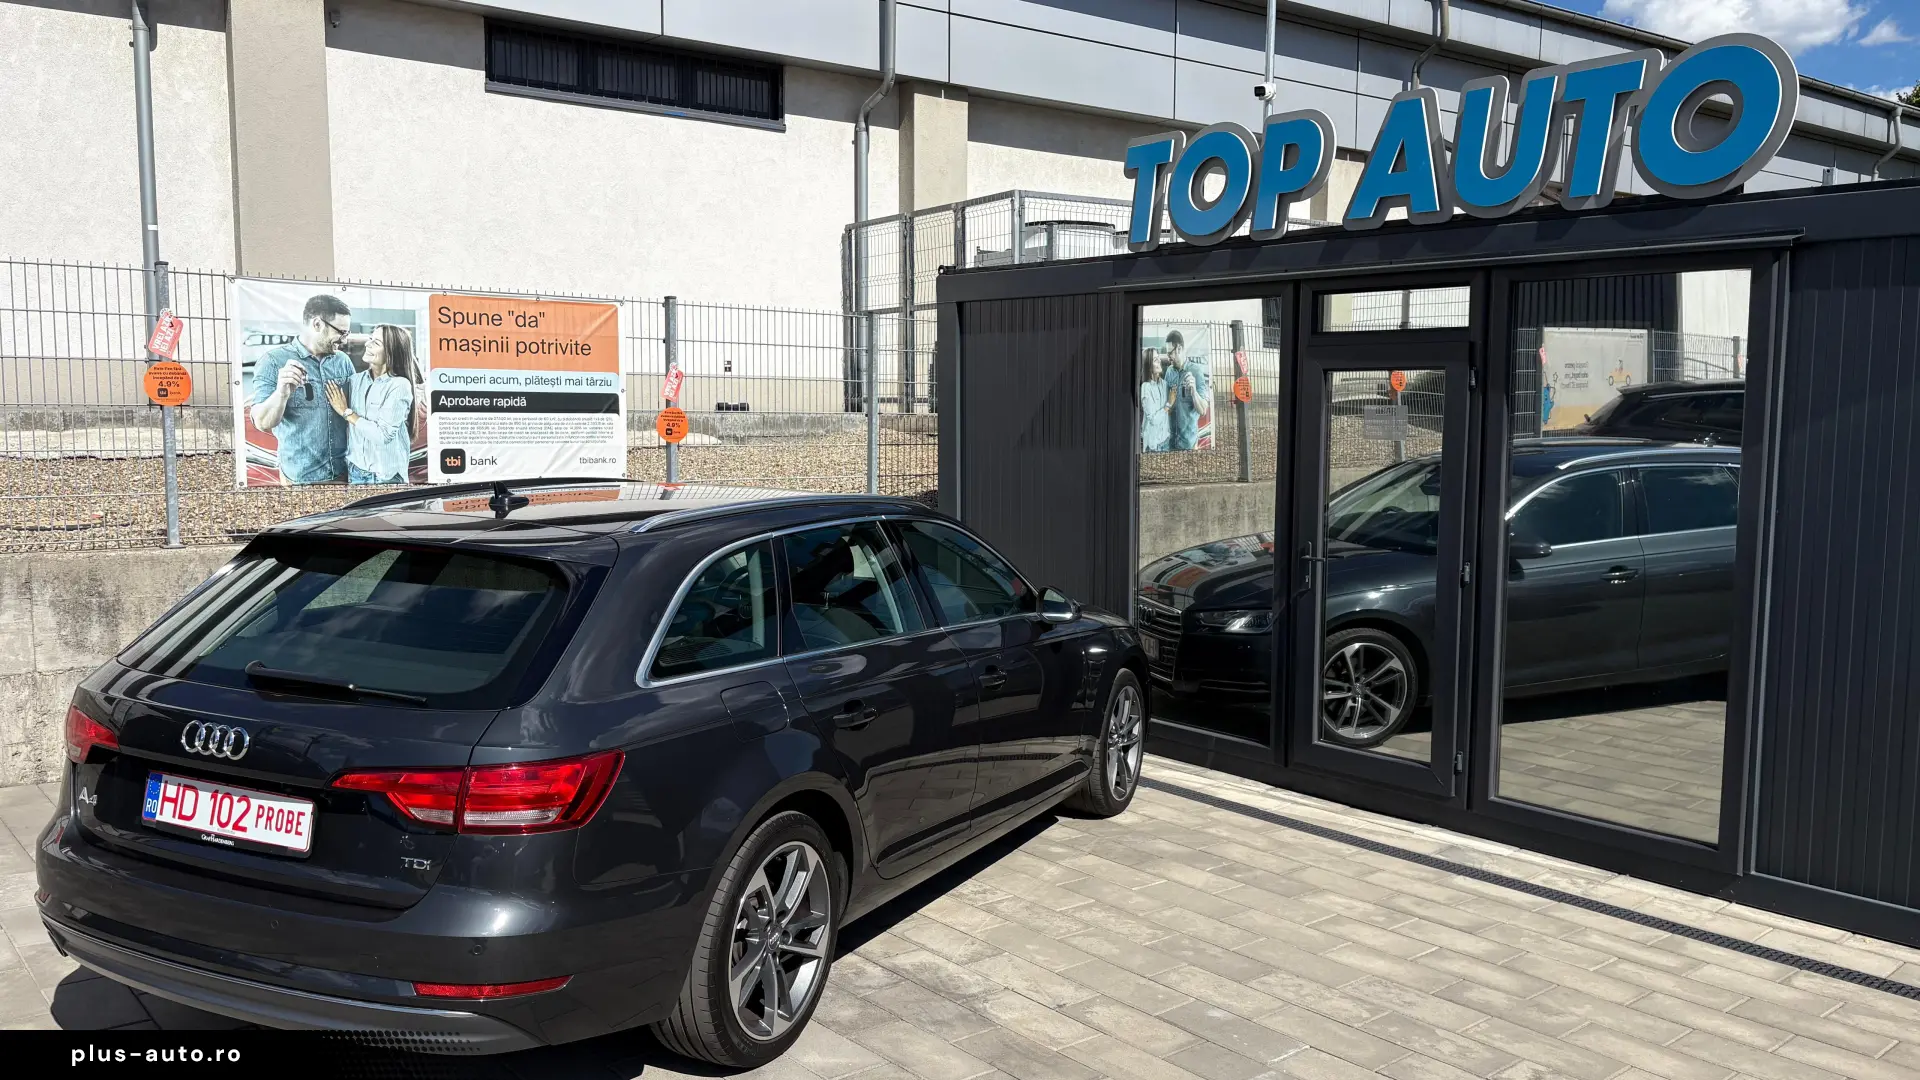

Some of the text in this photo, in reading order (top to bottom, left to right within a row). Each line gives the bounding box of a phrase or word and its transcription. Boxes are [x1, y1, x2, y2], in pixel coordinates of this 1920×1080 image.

[1125, 40, 1788, 246] TOP AUTO
[438, 306, 545, 328] Spune "da"
[438, 335, 592, 357] mașinii potrivite
[158, 380, 180, 388] 4.9%
[438, 372, 612, 388] Cumperi acum, plătești mai târziu
[438, 395, 527, 408] Aprobare rapidă
[444, 455, 498, 467] tbi bank
[579, 456, 617, 465] tbibank.ro
[78, 786, 98, 807] A4
[145, 780, 306, 837] RO HD 102 PROBE
